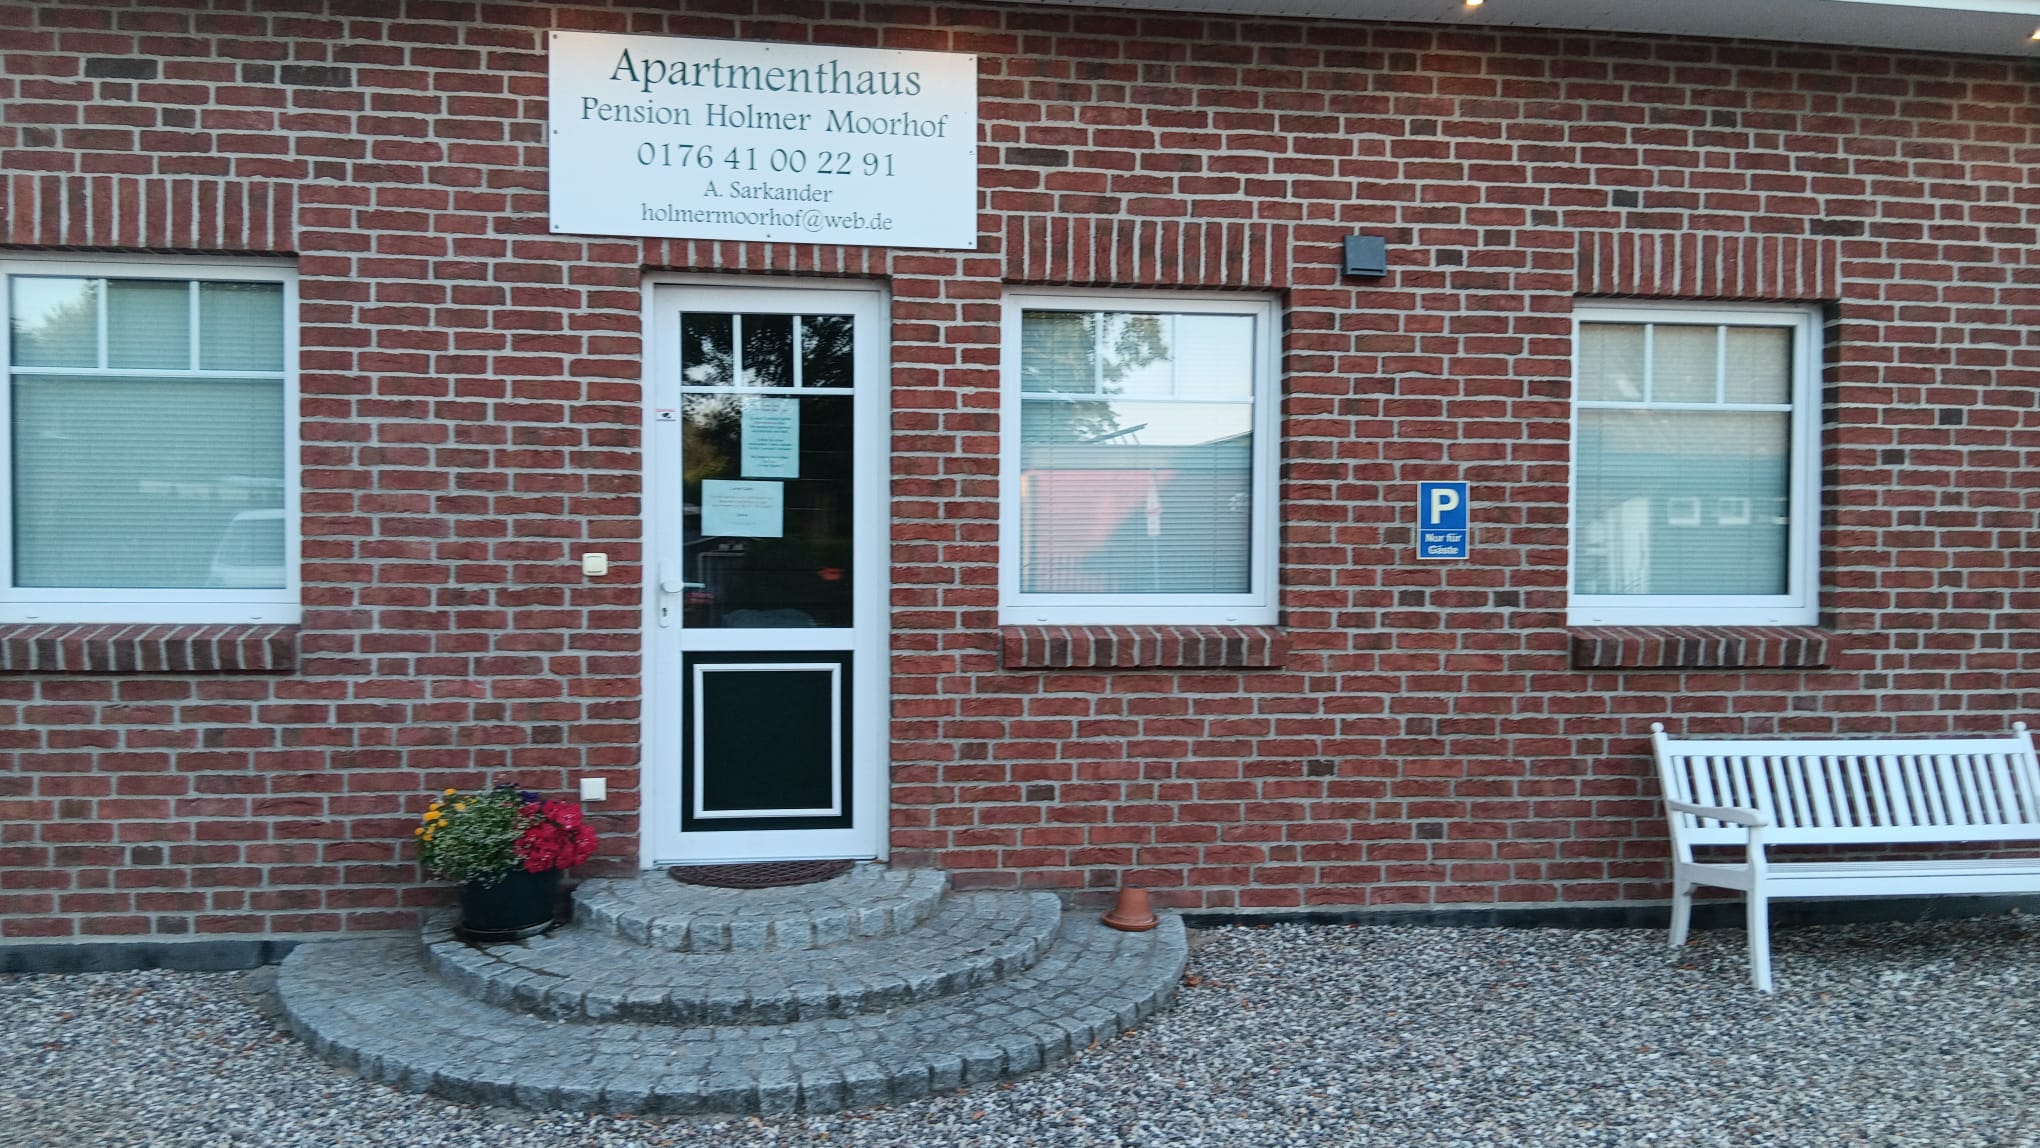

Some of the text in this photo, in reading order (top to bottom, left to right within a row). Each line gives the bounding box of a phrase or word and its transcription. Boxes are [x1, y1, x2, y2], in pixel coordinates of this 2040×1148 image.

[609, 47, 922, 96] Apartmenthaus
[580, 96, 949, 138] Pension Holmer Moorhof
[637, 141, 895, 177] 0176 41 00 22 91
[703, 180, 833, 203] A. Sarkander
[641, 202, 893, 232] holmermoorhof@web.de
[1430, 488, 1459, 524] P
[1425, 533, 1461, 542] Nur für
